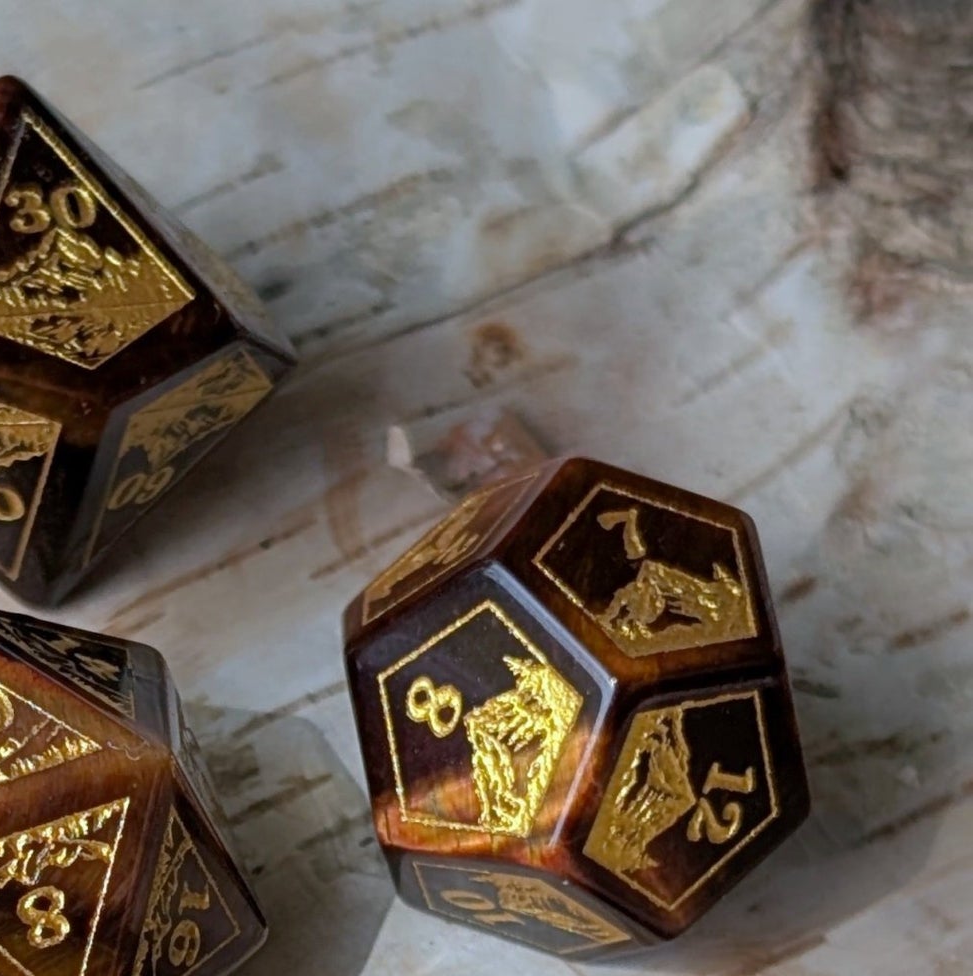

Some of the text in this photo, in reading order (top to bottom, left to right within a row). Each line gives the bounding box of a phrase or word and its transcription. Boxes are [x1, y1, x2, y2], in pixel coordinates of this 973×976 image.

[3, 183, 97, 234] 30
[596, 507, 647, 560] 7
[50, 632, 121, 682] 14
[405, 675, 463, 739] 8
[686, 762, 757, 845] 12
[15, 885, 71, 949] 8
[166, 879, 211, 968] 16
[440, 889, 526, 926] 10
